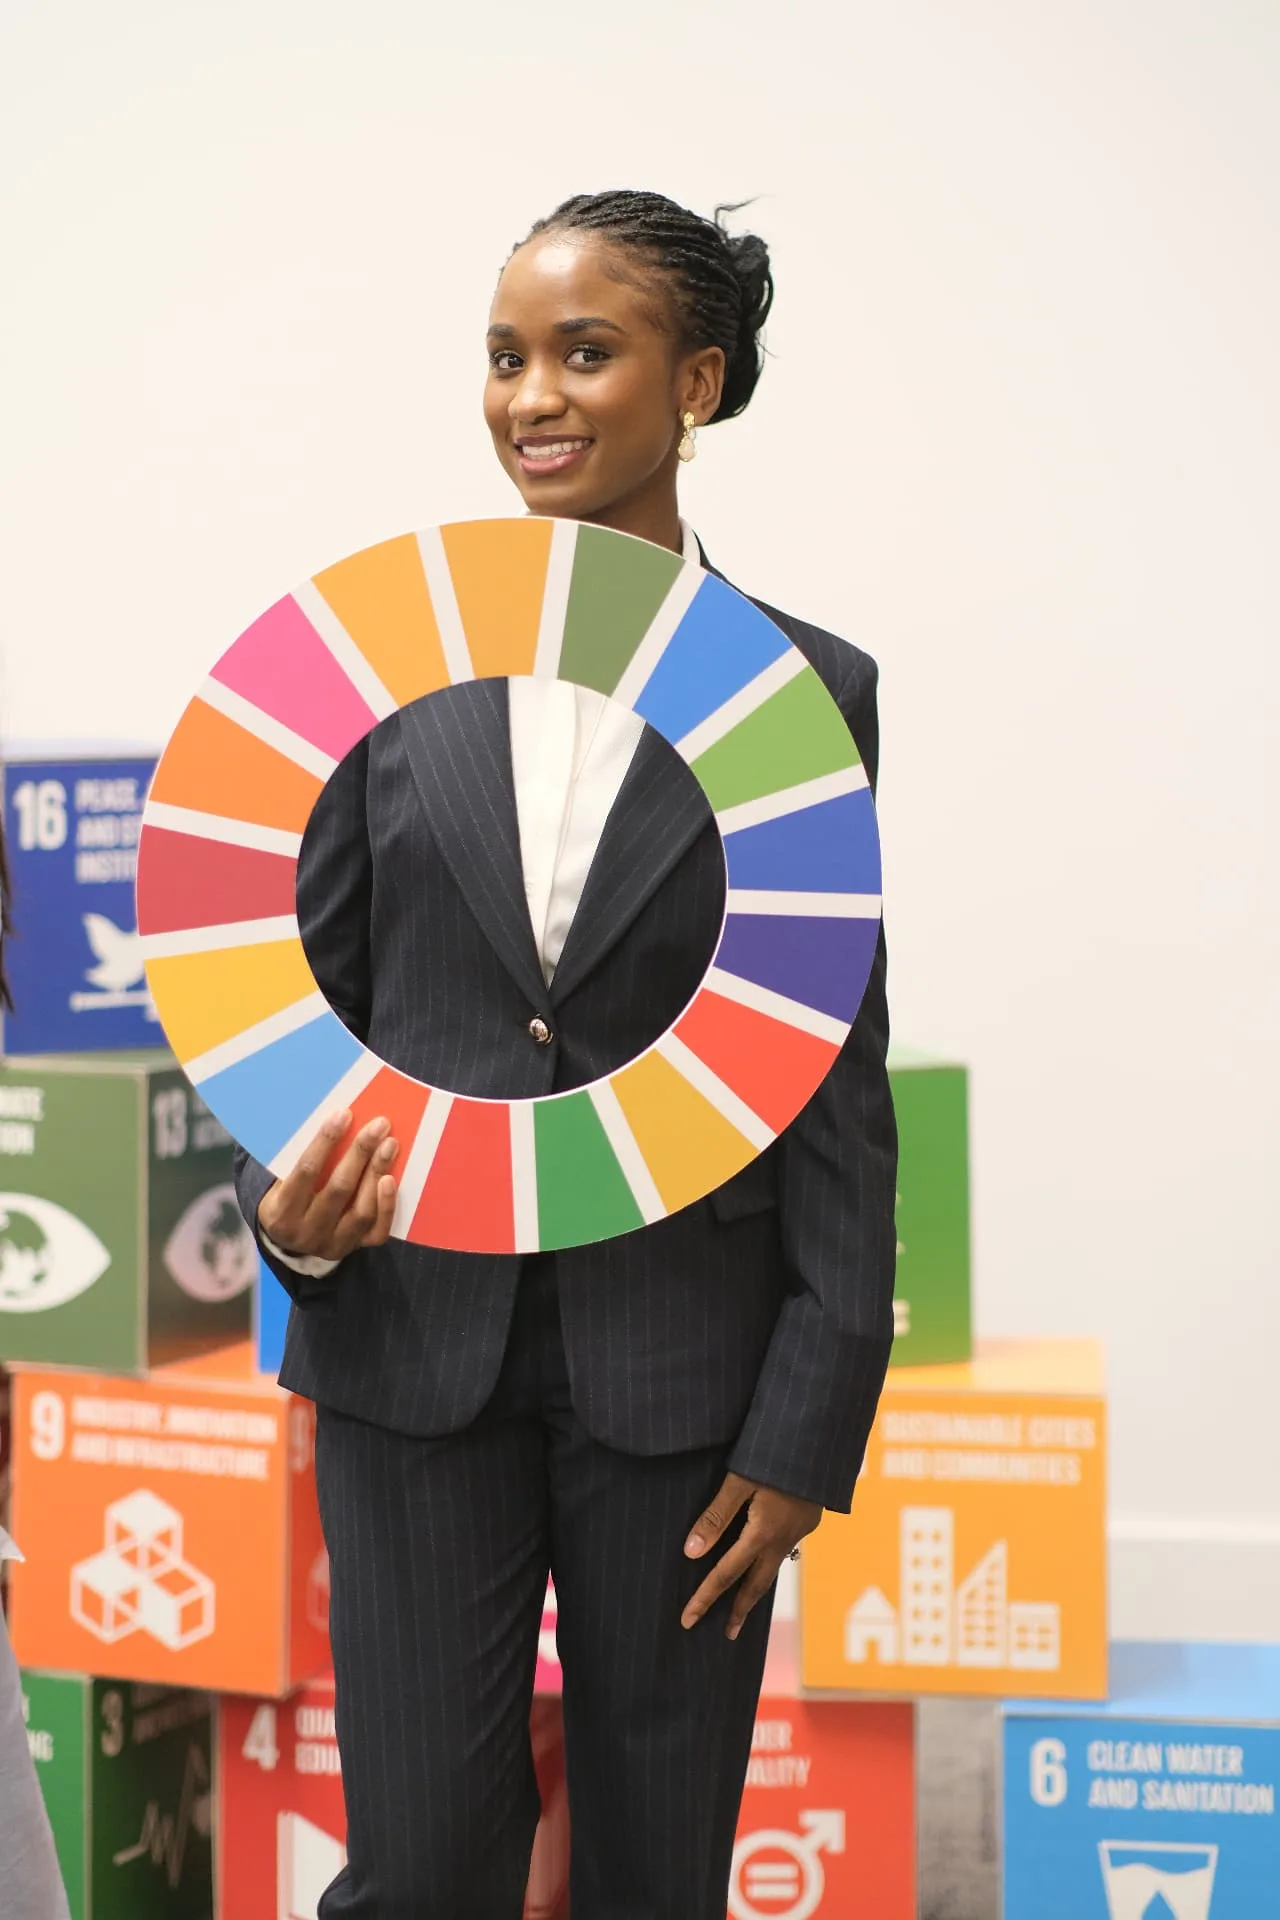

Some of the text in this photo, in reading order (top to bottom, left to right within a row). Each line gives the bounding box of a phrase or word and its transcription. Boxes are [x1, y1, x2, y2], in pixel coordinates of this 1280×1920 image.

[13, 780, 67, 850] 16
[155, 1088, 187, 1158] 13
[31, 1391, 65, 1460] 9
[102, 1690, 123, 1756] 3
[242, 1704, 280, 1771] 4
[1030, 1737, 1068, 1806] 6
[1087, 1740, 1244, 1777] CLEAN WATER
[1088, 1777, 1275, 1815] AND SANITATION
